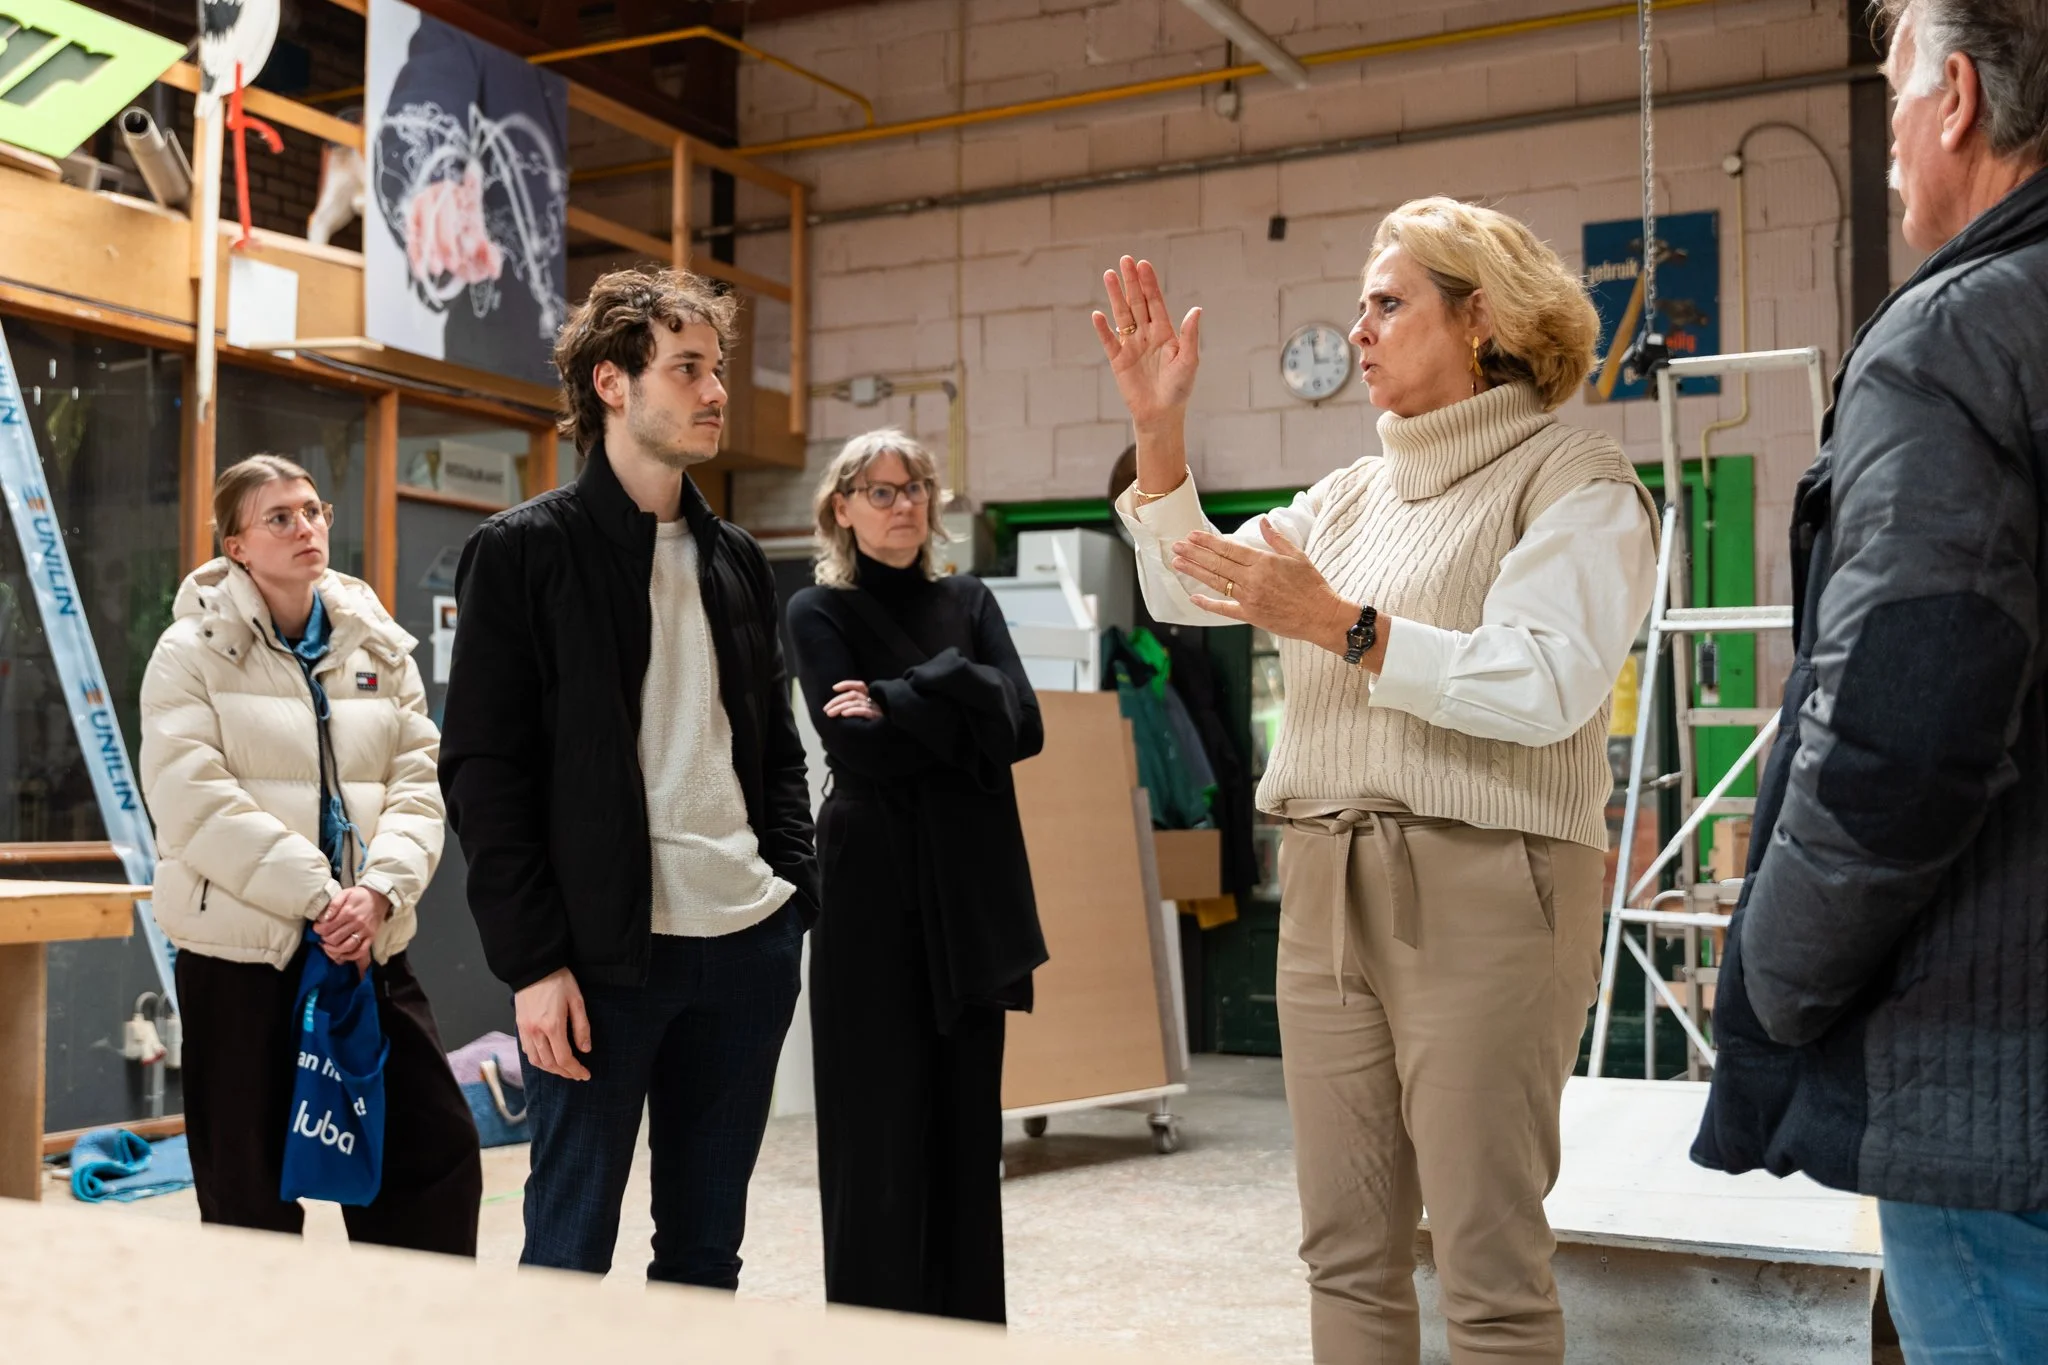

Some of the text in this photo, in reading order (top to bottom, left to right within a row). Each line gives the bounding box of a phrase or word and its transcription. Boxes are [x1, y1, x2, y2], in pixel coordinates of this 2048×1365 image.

[33, 516, 78, 616] UNILIN
[90, 709, 137, 812] UNILIN
[293, 1099, 356, 1156] luba
